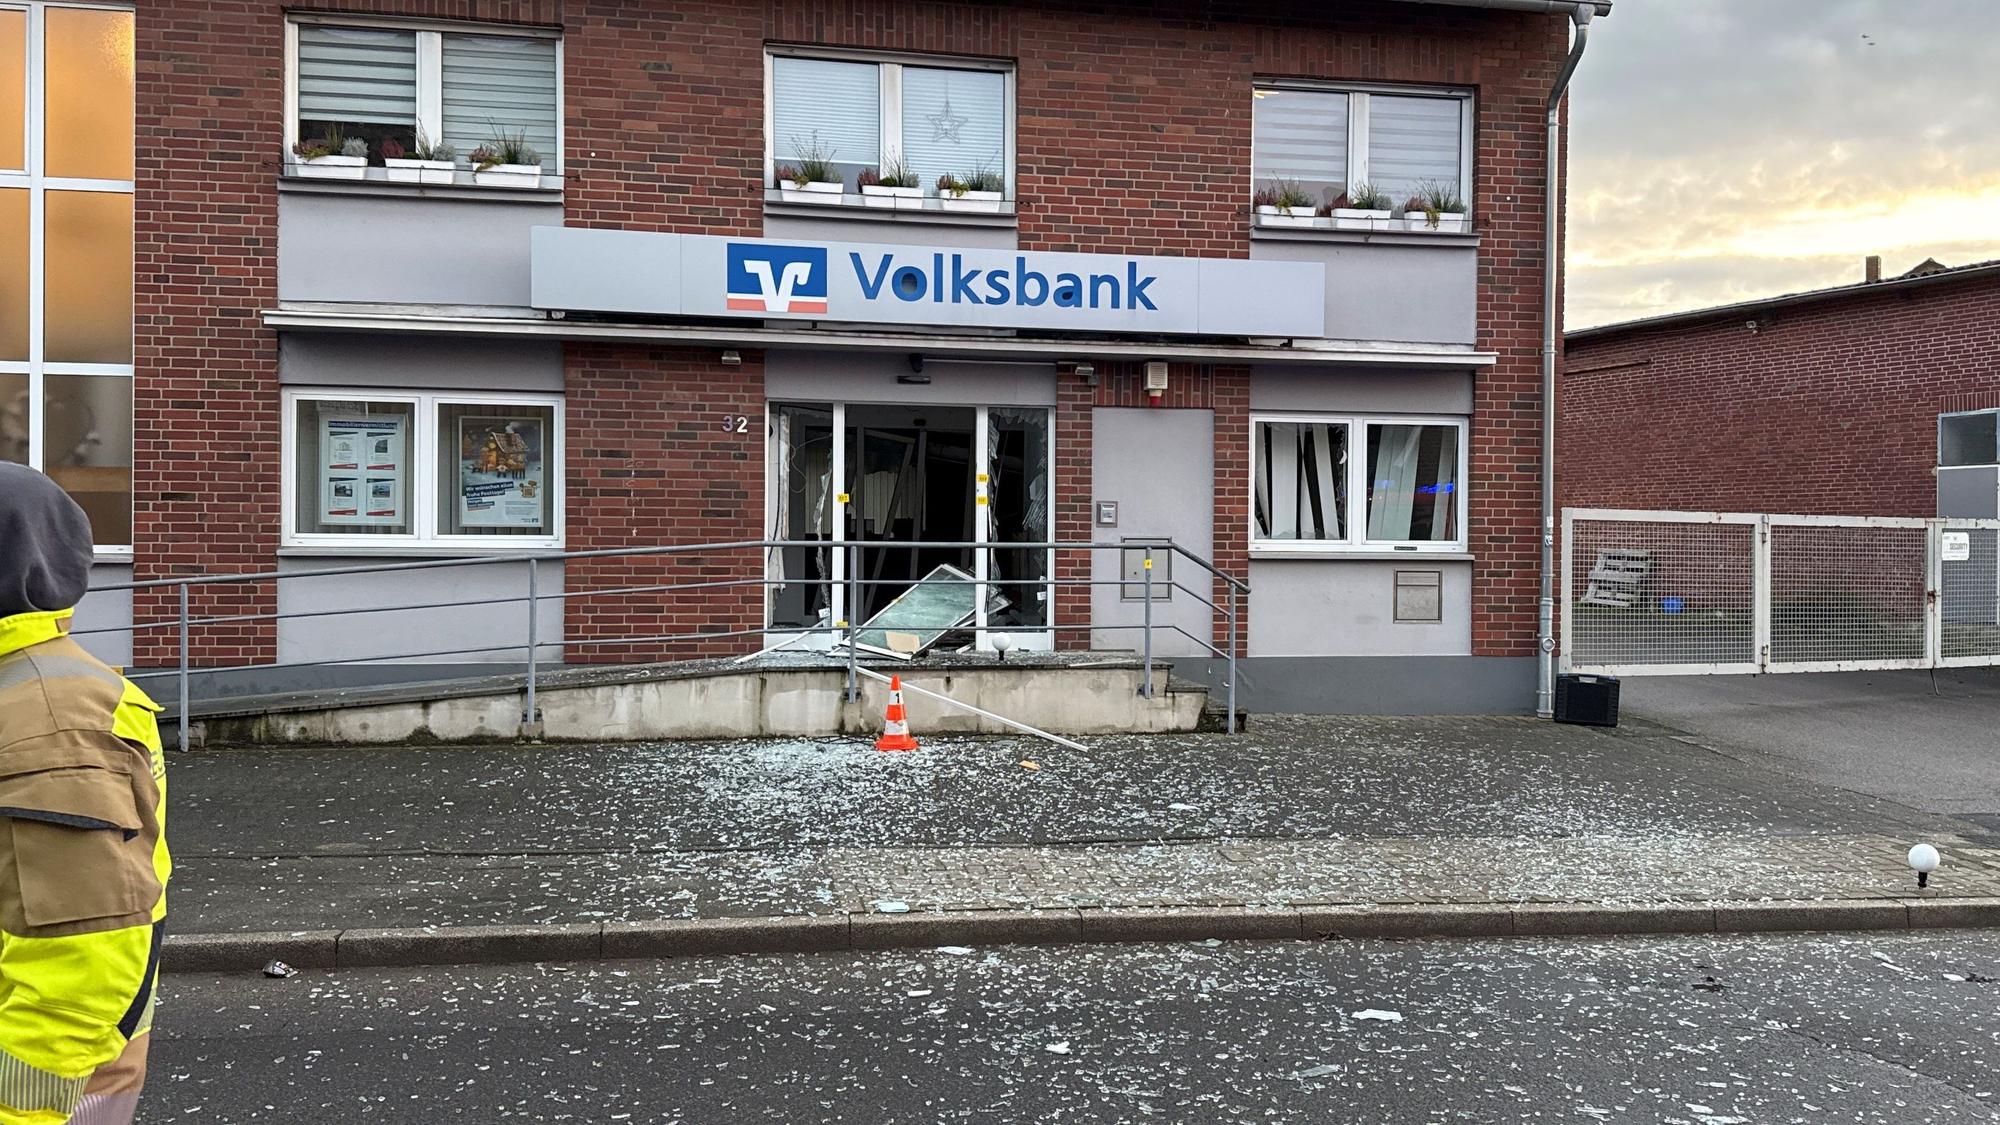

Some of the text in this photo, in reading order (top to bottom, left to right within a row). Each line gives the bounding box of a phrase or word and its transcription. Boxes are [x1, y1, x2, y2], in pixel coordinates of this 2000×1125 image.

[848, 252, 1159, 311] Volksbank
[722, 415, 748, 433] 32
[895, 692, 900, 704] 1
